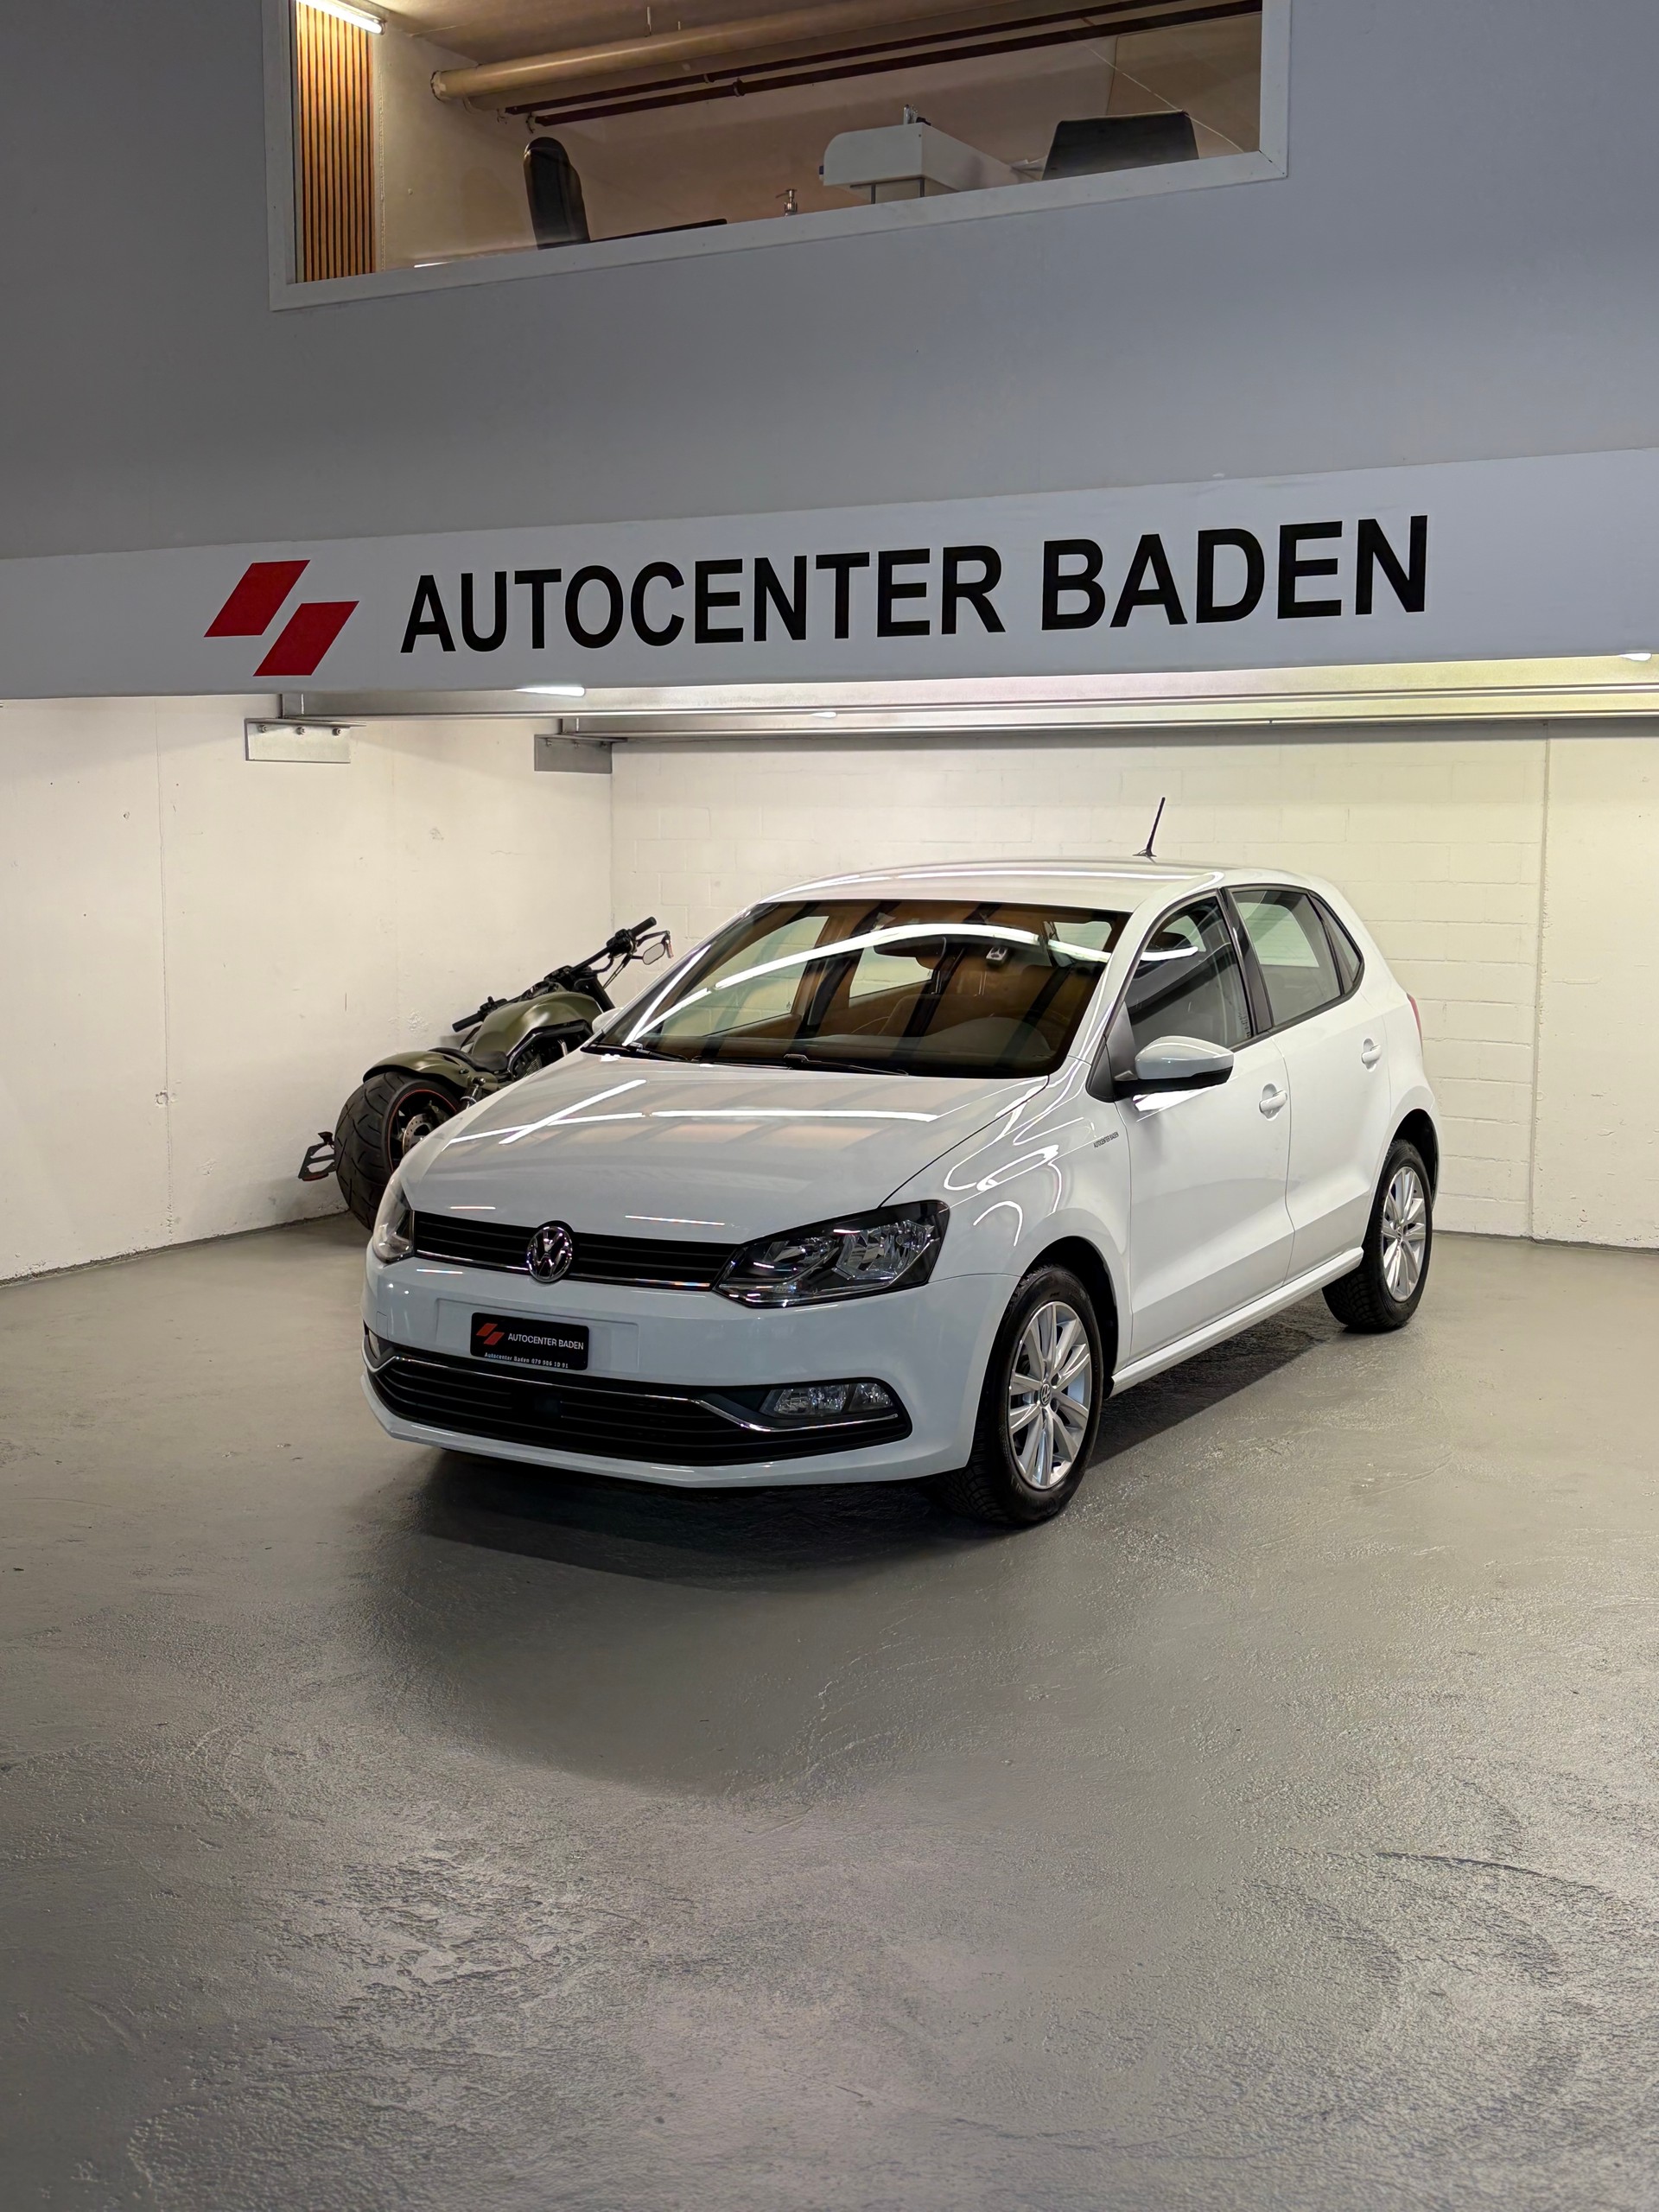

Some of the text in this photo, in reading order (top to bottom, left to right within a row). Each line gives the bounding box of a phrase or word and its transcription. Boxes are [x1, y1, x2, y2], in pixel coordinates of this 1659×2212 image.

[401, 516, 1428, 654] AUTOCENTER BADEN
[508, 1333, 583, 1350] AUTOCENTER BADEN
[484, 1352, 512, 1361] Autocenter
